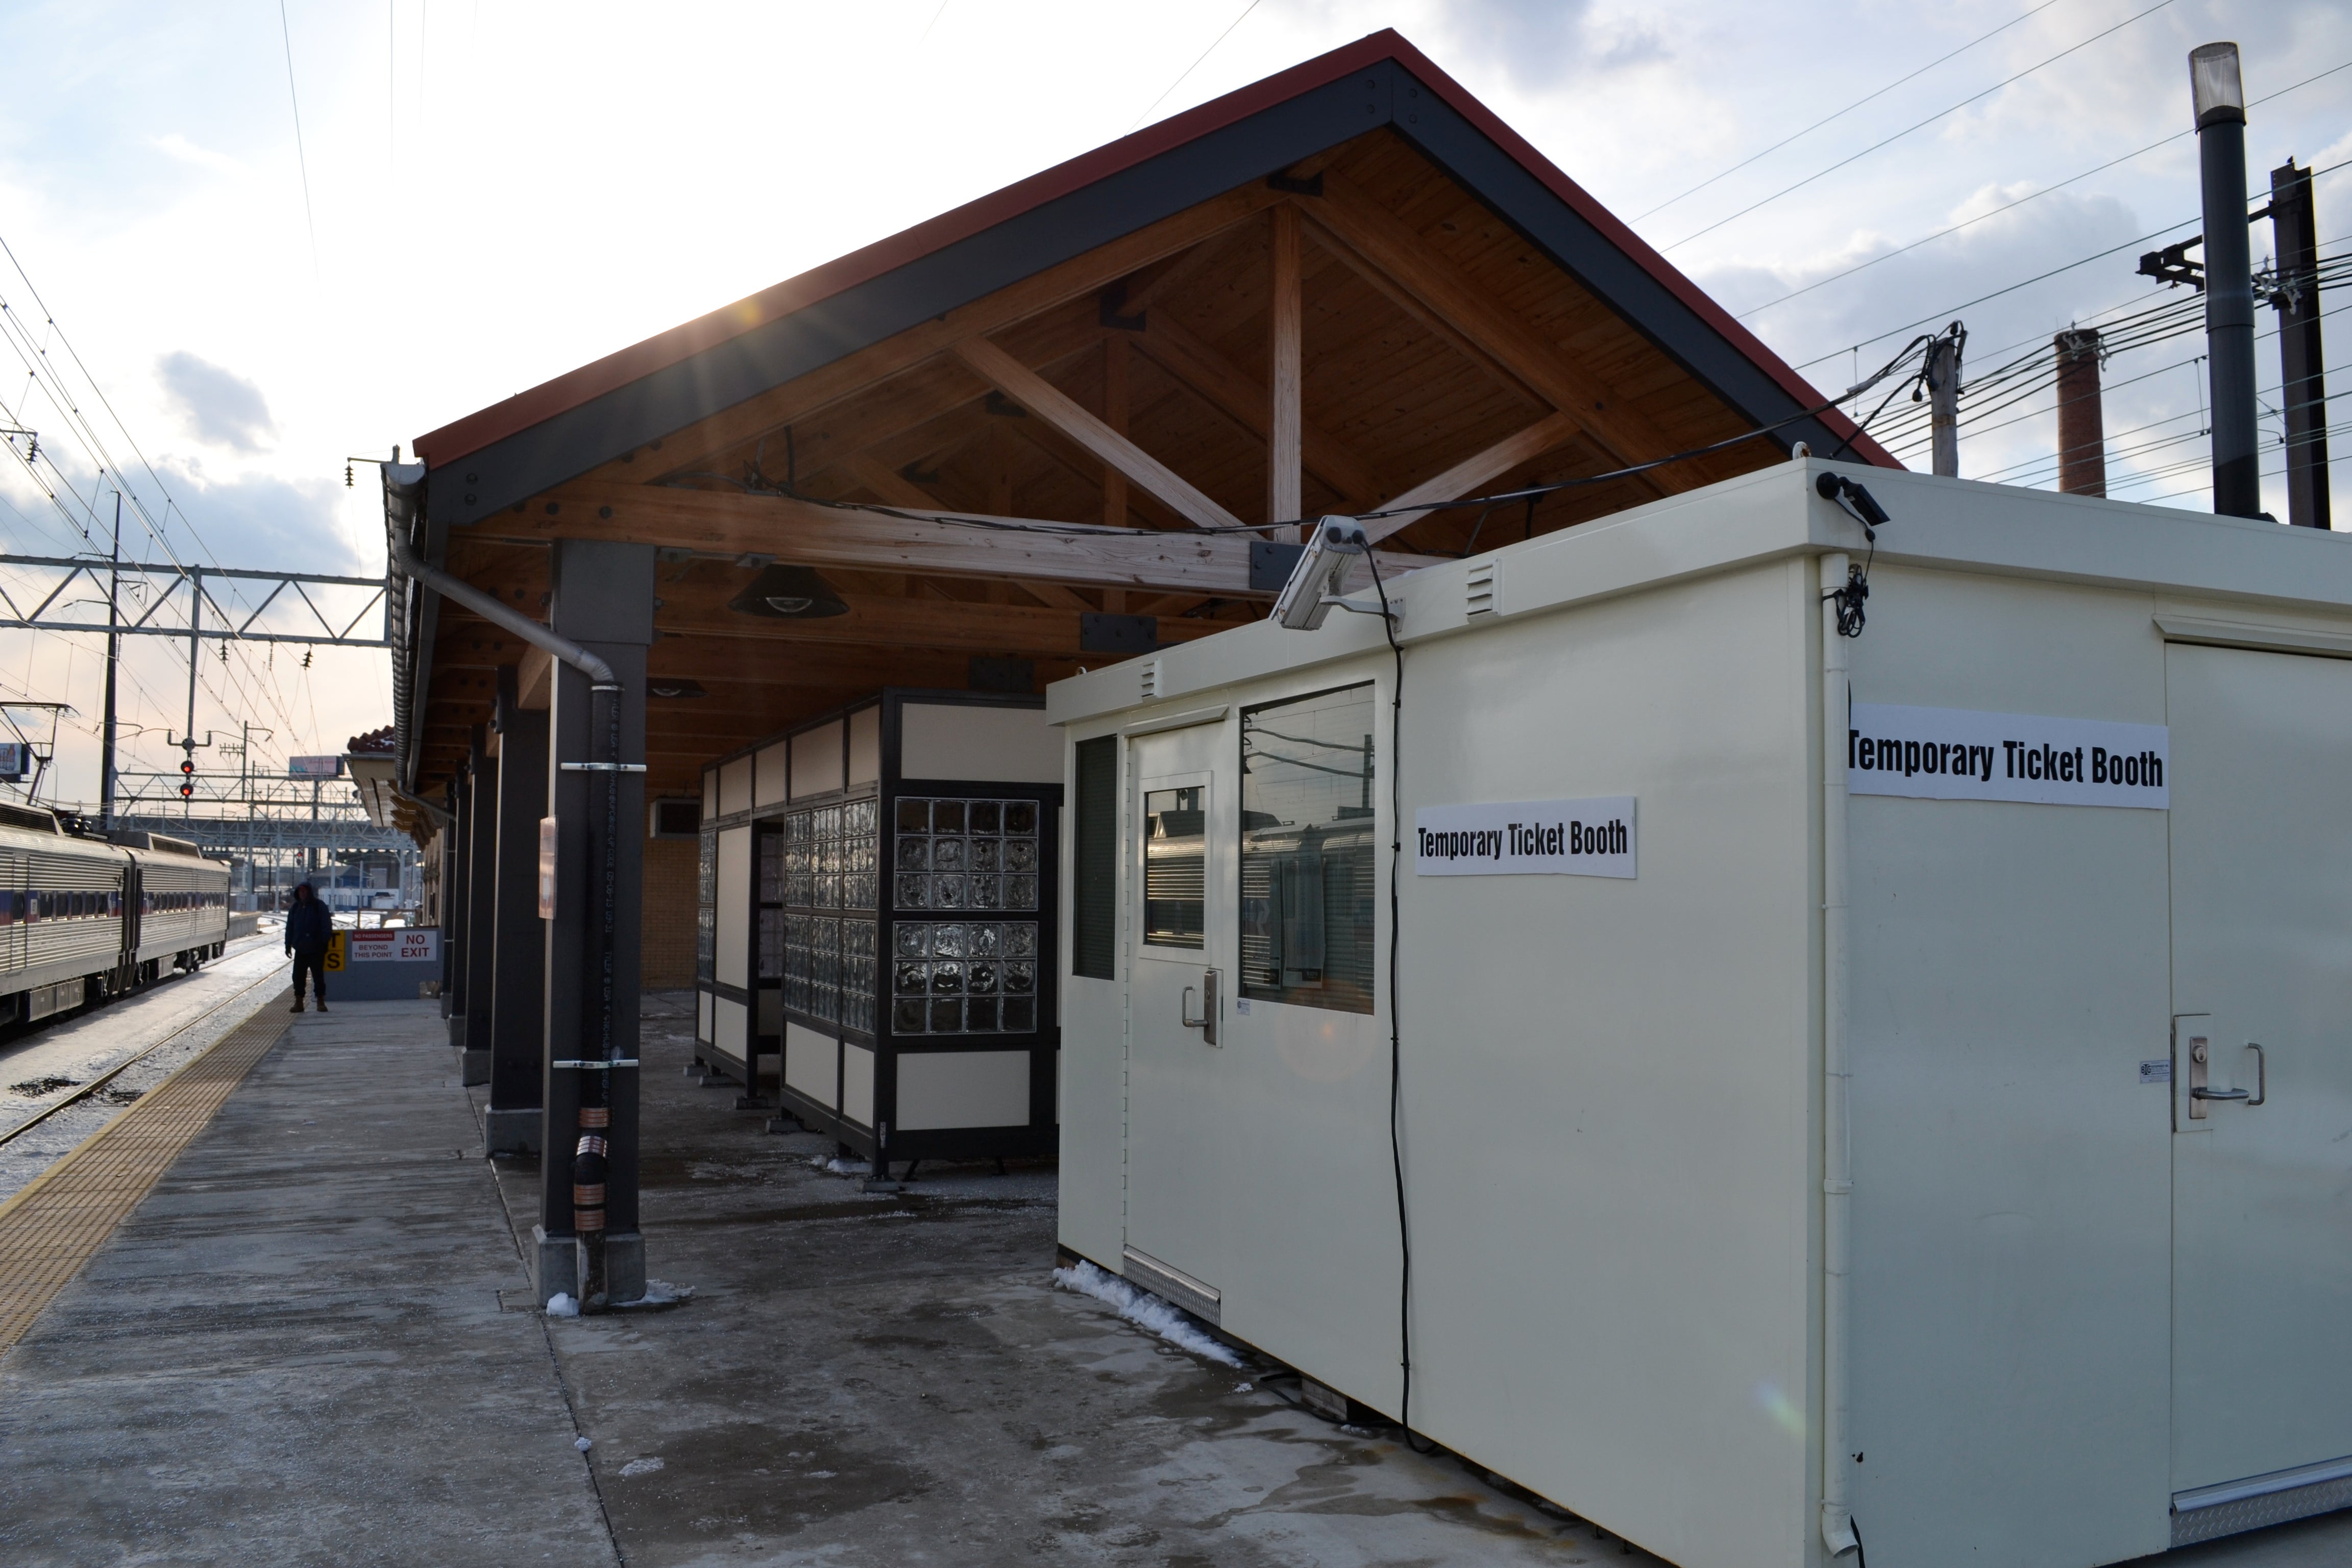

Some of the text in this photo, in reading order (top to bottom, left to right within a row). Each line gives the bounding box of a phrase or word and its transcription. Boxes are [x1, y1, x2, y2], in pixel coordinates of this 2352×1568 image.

[1849, 729, 2164, 787] Temporary Ticket Booth
[1418, 819, 1628, 861] Temporary Ticket Booth
[401, 947, 429, 957] EXIT
[406, 935, 425, 944] NO
